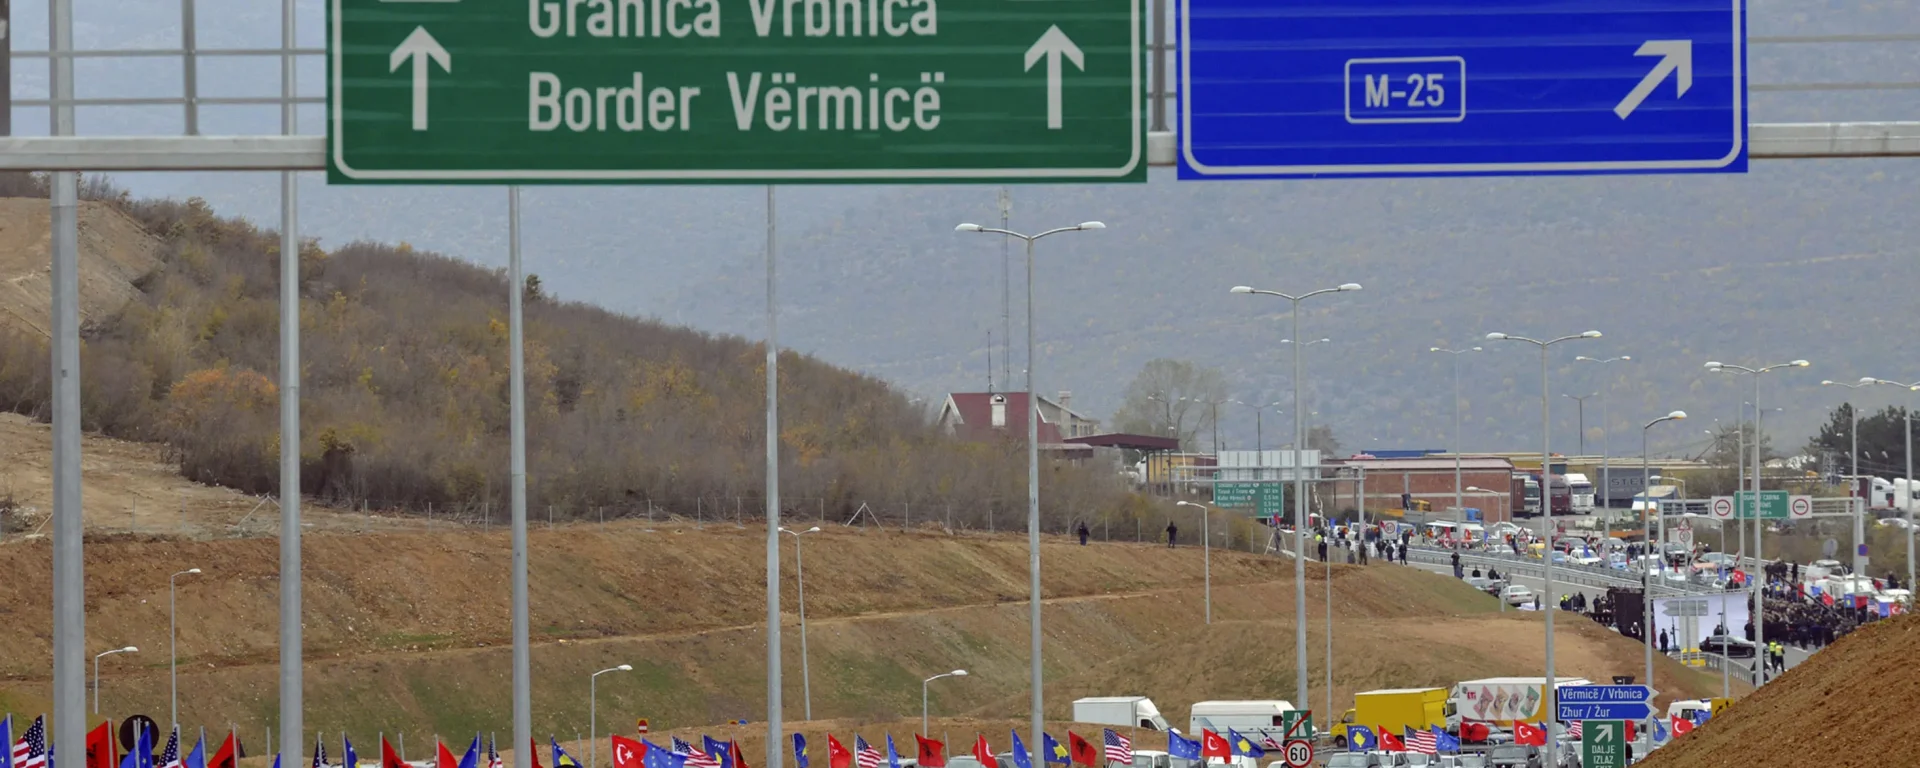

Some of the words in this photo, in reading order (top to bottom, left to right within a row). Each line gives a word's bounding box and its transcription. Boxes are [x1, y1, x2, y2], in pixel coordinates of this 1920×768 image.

[529, 0, 720, 37] Granica
[751, 0, 937, 37] Vrbnica
[1365, 73, 1444, 107] M-25
[529, 72, 700, 131] Border
[726, 72, 944, 131] Vërmicë
[1561, 688, 1599, 699] Vërmicë
[1600, 688, 1606, 700] /
[1608, 688, 1642, 699] Vrbnica
[1561, 706, 1583, 717] Zhur
[1586, 706, 1592, 718] /
[1290, 747, 1307, 761] 60
[1592, 745, 1615, 754] DALJE
[1594, 756, 1614, 764] IZLAZ
